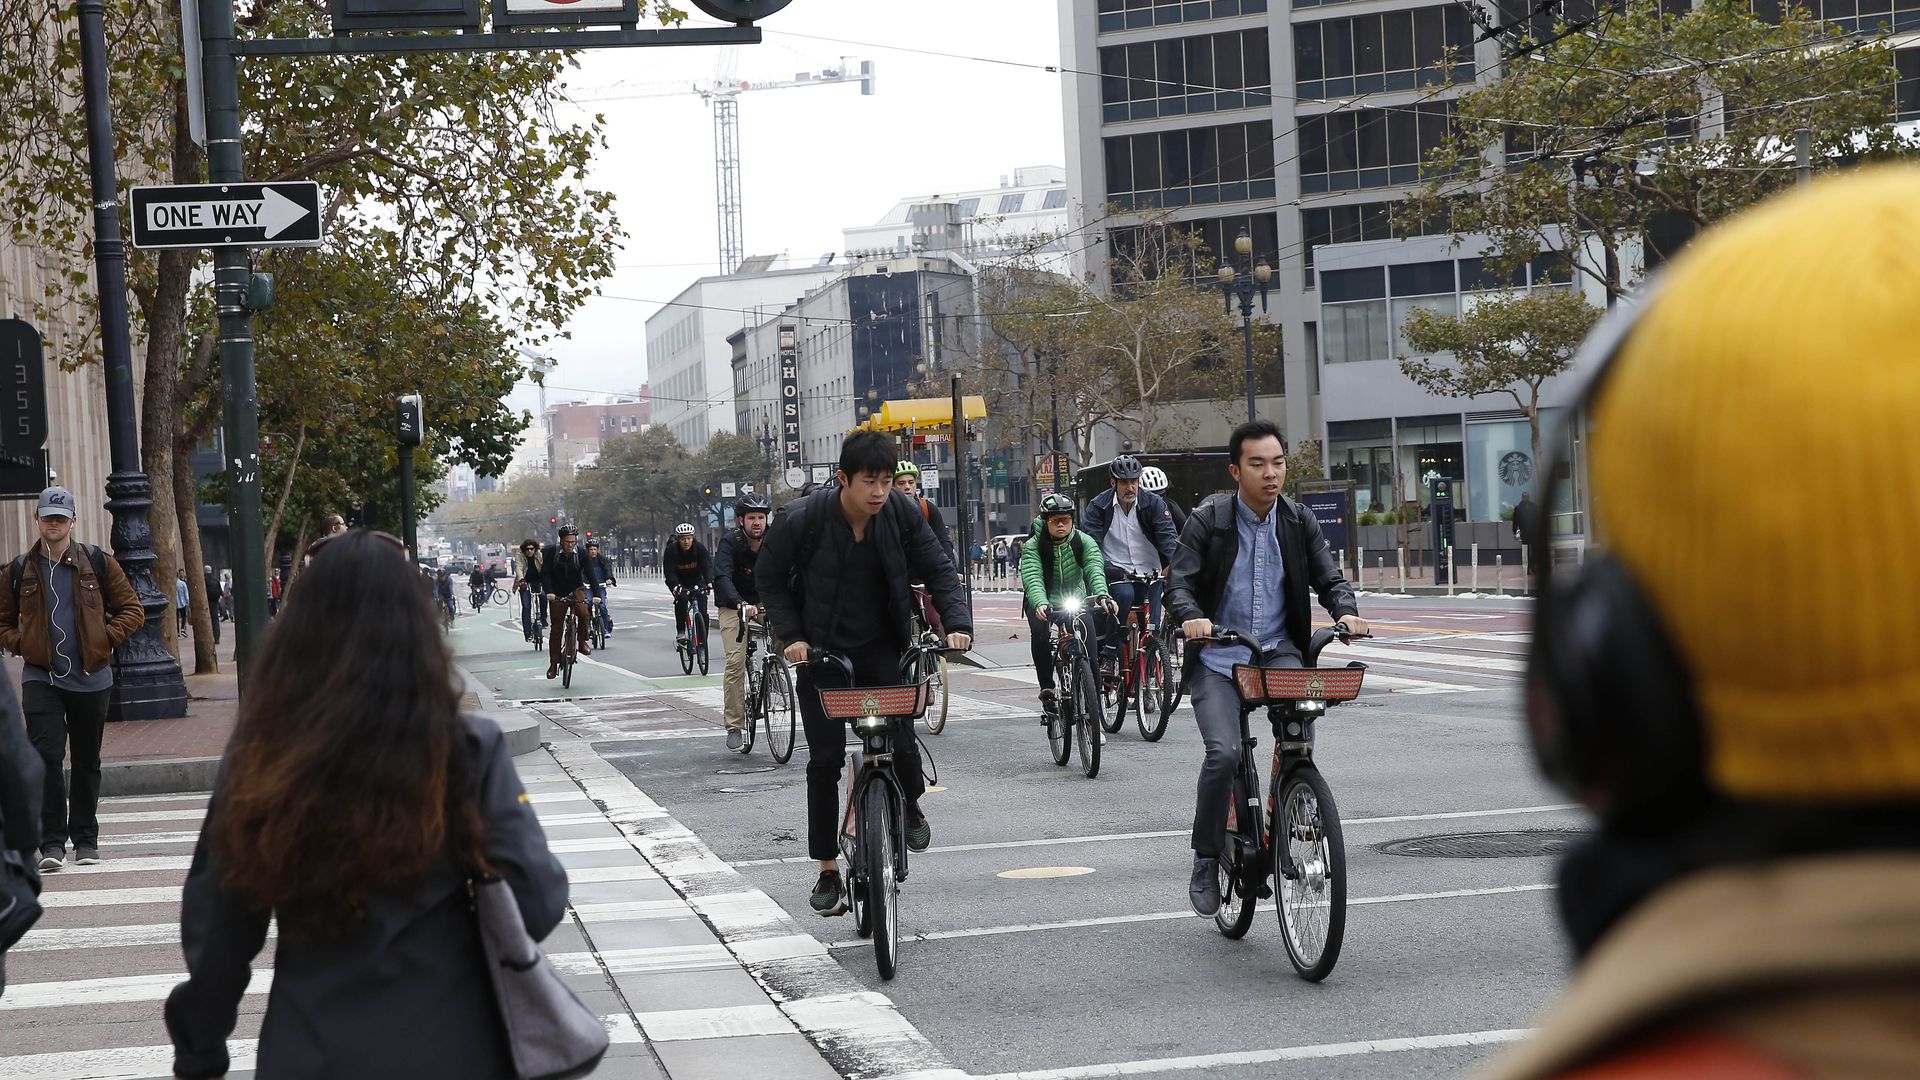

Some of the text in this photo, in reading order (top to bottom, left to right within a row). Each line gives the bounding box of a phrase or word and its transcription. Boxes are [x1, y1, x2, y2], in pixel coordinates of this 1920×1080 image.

[153, 202, 263, 228] ONE WAY
[15, 338, 30, 436] 1355
[49, 493, 65, 505] Cal
